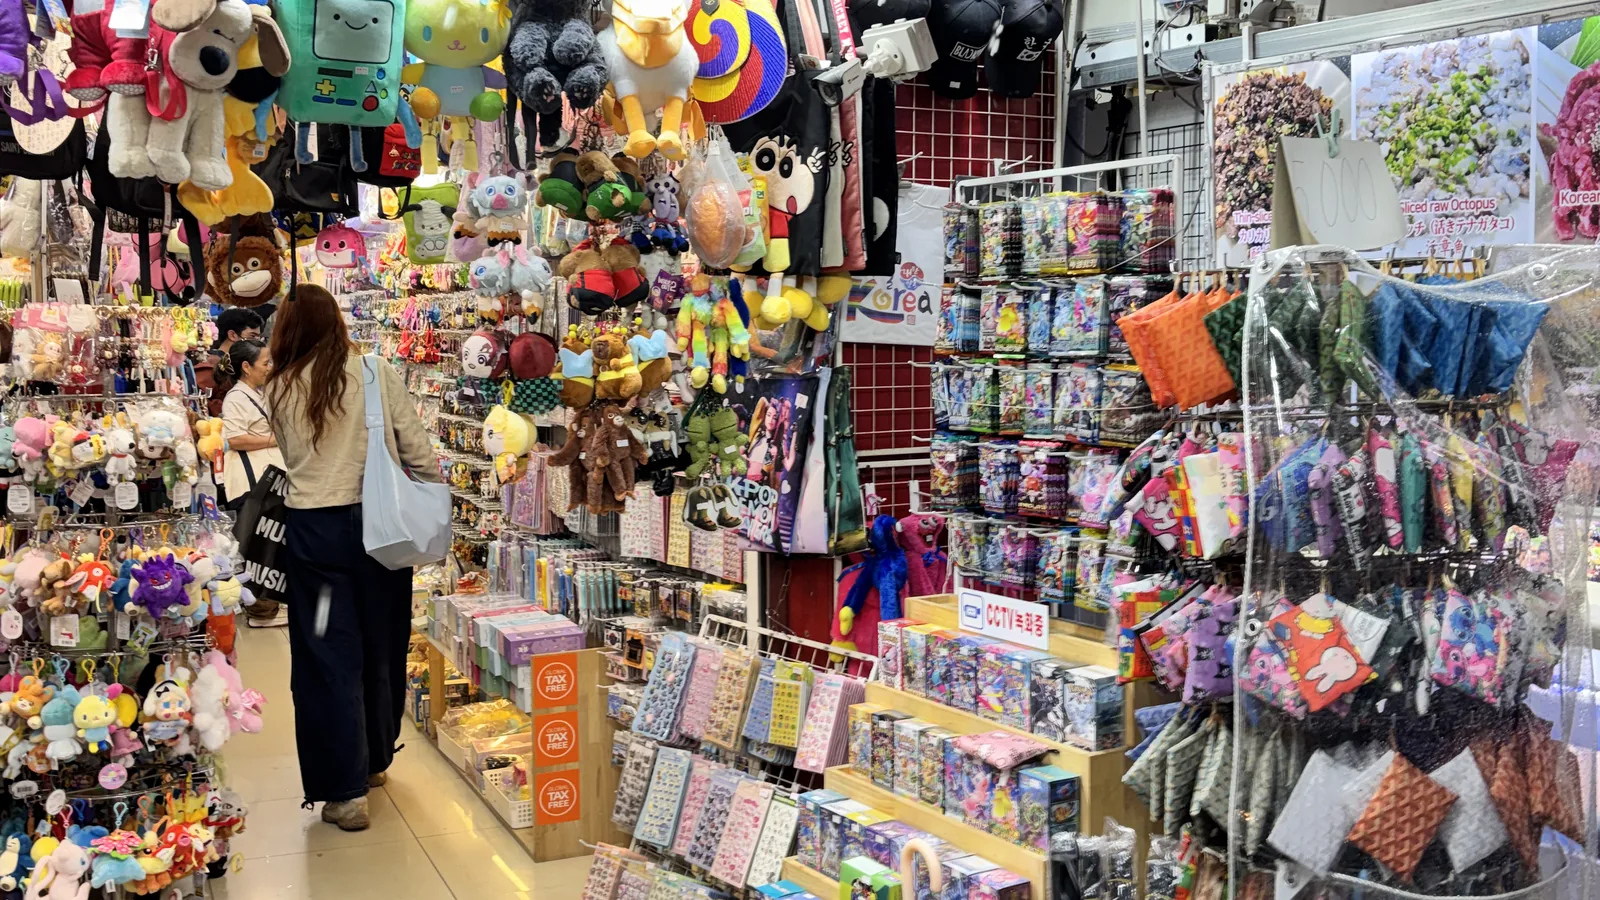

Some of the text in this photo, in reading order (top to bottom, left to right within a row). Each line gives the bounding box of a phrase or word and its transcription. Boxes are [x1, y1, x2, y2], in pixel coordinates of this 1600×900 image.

[1429, 201, 1449, 212] raw
[1450, 198, 1496, 213] Octopus
[544, 674, 567, 684] TAX
[545, 683, 567, 693] FREE
[545, 731, 568, 742] TAX
[546, 741, 568, 751] FREE
[547, 789, 569, 800] TAX
[547, 800, 570, 809] FREE
